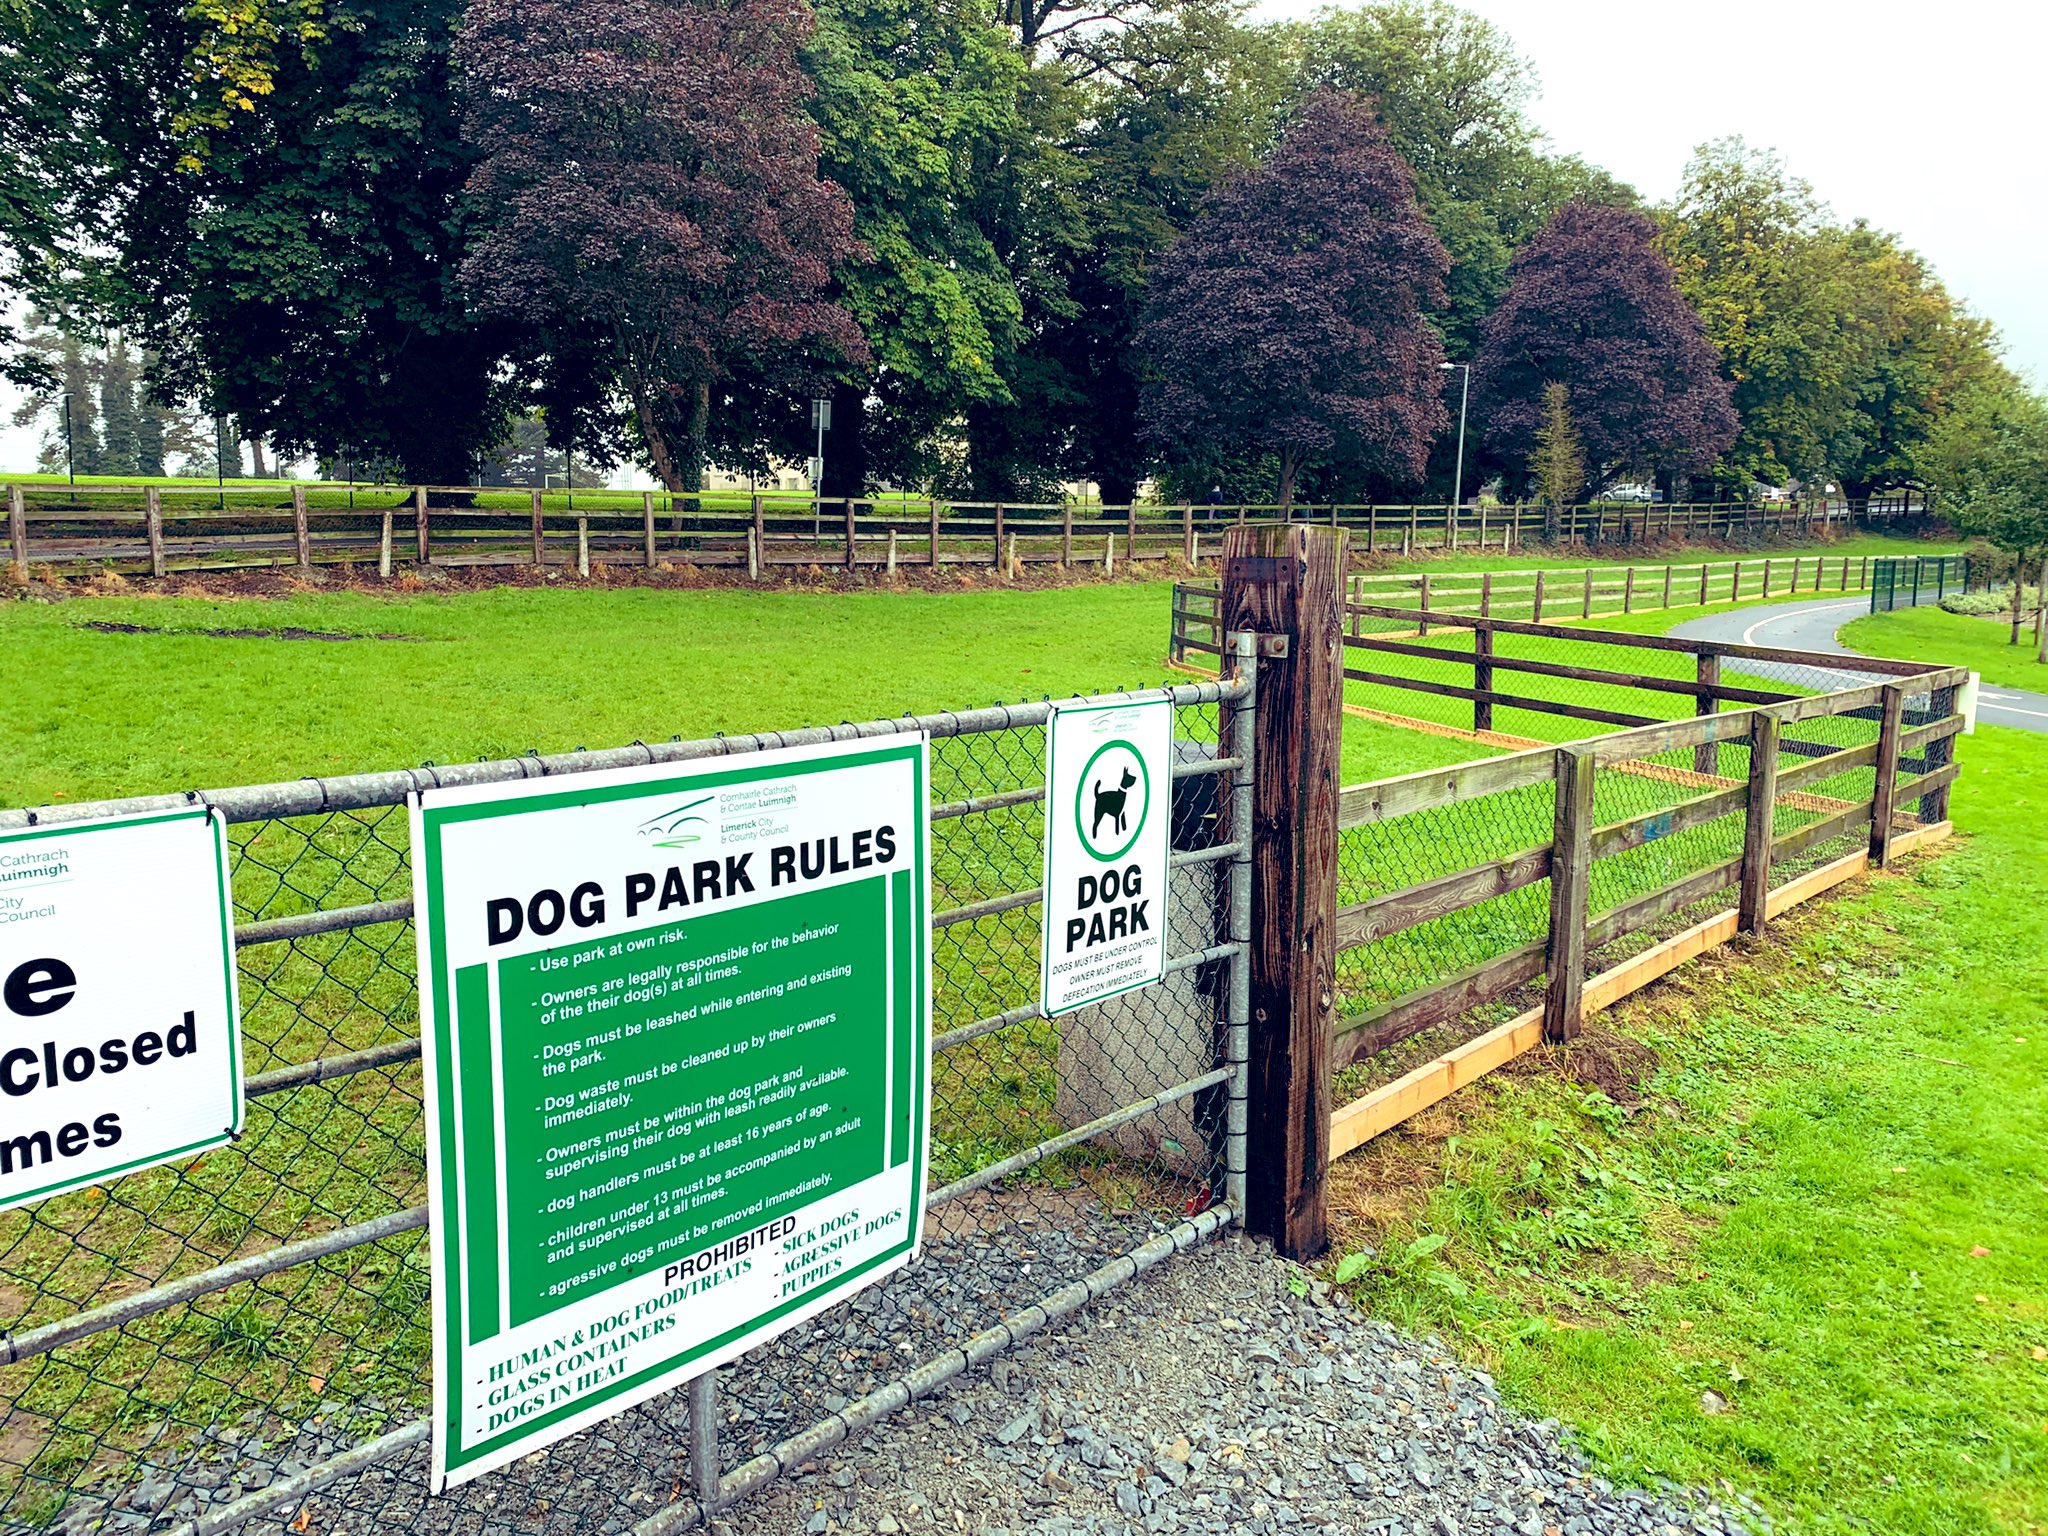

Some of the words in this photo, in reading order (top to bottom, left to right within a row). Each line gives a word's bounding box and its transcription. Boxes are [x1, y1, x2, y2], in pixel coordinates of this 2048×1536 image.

[720, 789, 761, 803] Comhairle
[763, 784, 797, 796] Cathrach
[720, 805, 726, 813] &
[728, 801, 757, 812] Contae
[759, 795, 797, 807] Luimnigh
[721, 820, 757, 833] Limerick
[758, 818, 774, 827] City
[721, 836, 727, 844] &
[729, 830, 758, 843] County
[760, 825, 789, 837] Council
[0, 849, 69, 867] Cathrach
[0, 863, 69, 882] uimnigh
[486, 882, 606, 946] DOG
[625, 852, 755, 918] PARK
[771, 825, 897, 887] RULES
[0, 905, 56, 924] Council
[1077, 864, 1142, 911] DOG
[540, 957, 569, 972] Use
[573, 946, 605, 967] park
[609, 942, 623, 956] at
[626, 936, 655, 952] own
[659, 928, 687, 945] risk.
[1066, 899, 1150, 953] PARK
[541, 984, 598, 1007] Owners
[602, 978, 624, 992] are
[628, 965, 672, 986] legally
[676, 946, 749, 973] responsible
[752, 942, 768, 954] for
[771, 936, 789, 949] the
[792, 923, 839, 944] behavior
[1052, 961, 1073, 975] DOGS
[1074, 955, 1093, 968] MUST
[1094, 952, 1103, 962] BE
[1105, 945, 1128, 959] UNDER
[1129, 936, 1158, 952] CONTROL
[1069, 969, 1095, 985] OWNER
[1096, 963, 1115, 976] MUST
[1115, 955, 1143, 970] REMOVE
[541, 1009, 557, 1025] of
[560, 1005, 583, 1020] the
[587, 994, 620, 1013] their
[624, 981, 667, 1003] dog(s)
[671, 977, 683, 991] at
[687, 971, 701, 987] all
[705, 965, 742, 982] times.
[543, 1040, 581, 1059] Dogs
[586, 1027, 622, 1047] must
[625, 1024, 642, 1037] be
[646, 1005, 697, 1031] leashed
[701, 997, 733, 1015] while
[736, 984, 783, 1005] entering
[787, 975, 807, 991] and
[810, 964, 852, 984] existing
[1062, 981, 1105, 1003] DEFECATION
[1106, 968, 1148, 988] IMMEDIATELY
[0, 1011, 197, 1097] Closed
[542, 1062, 566, 1077] the
[570, 1049, 606, 1072] park.
[545, 1093, 575, 1112] Dog
[578, 1079, 620, 1101] waste
[624, 1066, 658, 1087] must
[661, 1063, 677, 1075] be
[681, 1044, 729, 1069] cleaned
[733, 1040, 748, 1054] up
[751, 1035, 766, 1048] by
[769, 1025, 795, 1042] their
[797, 1013, 837, 1033] owners
[544, 1092, 633, 1129] immediately.
[545, 1143, 629, 1180] supervising
[632, 1129, 663, 1150] their
[667, 1122, 692, 1139] dog
[695, 1110, 721, 1129] with
[725, 1098, 755, 1119] leash
[759, 1084, 797, 1107] readily
[799, 1066, 849, 1092] available.
[546, 1136, 601, 1162] Owners
[605, 1121, 640, 1143] must
[643, 1116, 660, 1130] be
[663, 1101, 702, 1123] within
[705, 1096, 725, 1110] the
[728, 1086, 751, 1101] dog
[754, 1074, 780, 1096] park
[782, 1065, 803, 1083] and
[547, 1195, 575, 1213] dog
[579, 1172, 640, 1202] handlers
[643, 1156, 677, 1179] must
[679, 1152, 695, 1165] be
[699, 1144, 711, 1159] at
[714, 1133, 743, 1154] least
[745, 1127, 759, 1141] 16
[762, 1116, 793, 1139] years
[795, 1109, 807, 1123] of
[809, 1103, 832, 1118] age.
[547, 1216, 606, 1247] children
[609, 1199, 650, 1223] under
[653, 1191, 668, 1207] 13
[671, 1178, 704, 1200] must
[706, 1173, 722, 1187] be
[724, 1140, 801, 1179] accompanied
[803, 1135, 817, 1150] by
[819, 1131, 833, 1143] an
[835, 1117, 862, 1137] adult
[547, 1243, 575, 1264] and
[578, 1212, 654, 1251] supervised
[657, 1206, 670, 1221] at
[673, 1198, 688, 1215] all
[691, 1187, 729, 1208] times.
[548, 1260, 617, 1296] agressive
[620, 1246, 654, 1267] dogs
[657, 1230, 690, 1252] must
[693, 1224, 708, 1238] be
[711, 1199, 763, 1231] removed
[765, 1172, 833, 1209] immediately.
[664, 1215, 796, 1287] PROHIBITED
[781, 1227, 861, 1277] AGRESSIVE
[865, 1207, 903, 1236] DOGS
[782, 1230, 817, 1255] SICK
[820, 1207, 860, 1238] DOGS
[782, 1256, 842, 1299] PUPPIES
[488, 1335, 567, 1384] HUMAN
[571, 1329, 585, 1348] &
[589, 1310, 631, 1340] DOG
[635, 1257, 752, 1321] FOOD/TREATS
[488, 1367, 550, 1407] GLASS
[555, 1312, 676, 1377] CONTAINERS
[488, 1393, 545, 1432] DOGS
[550, 1380, 572, 1404] IN
[577, 1356, 628, 1393] HEAT
